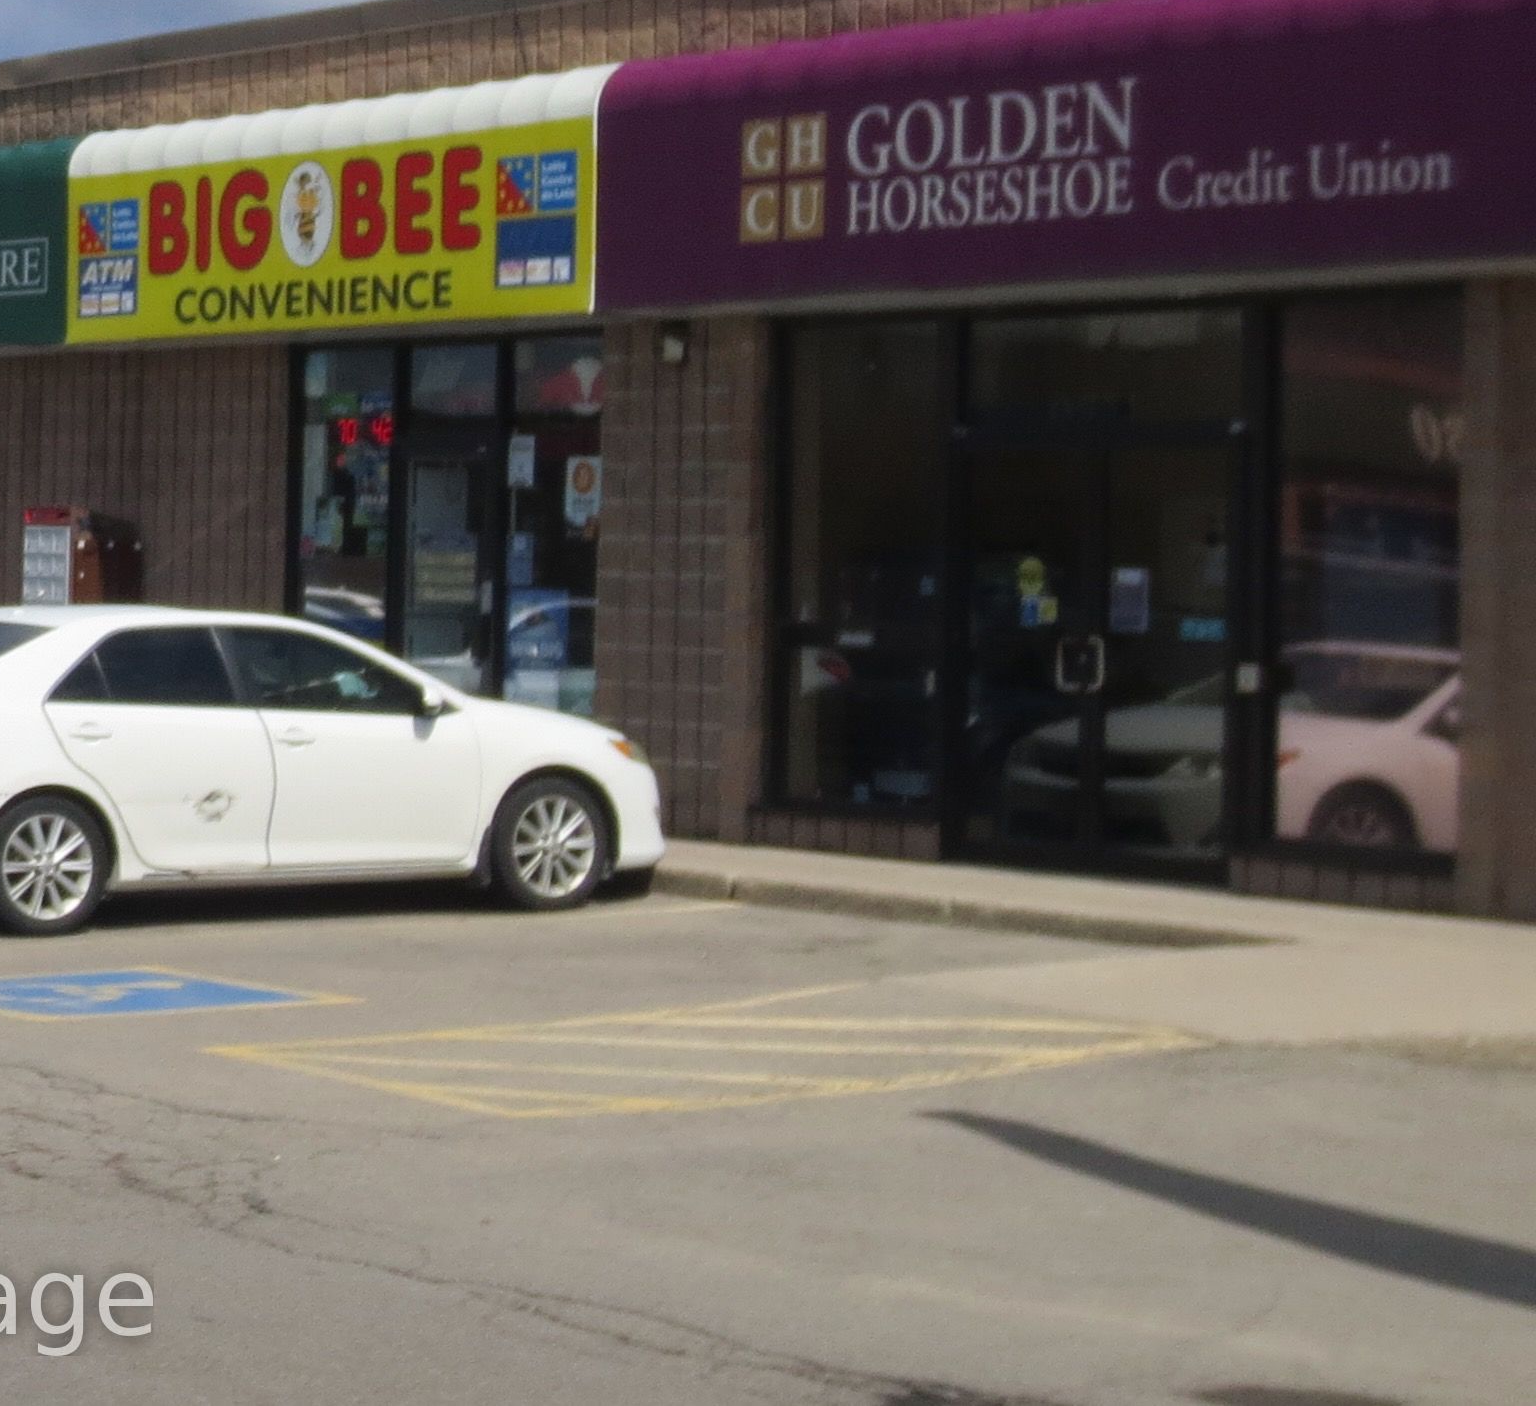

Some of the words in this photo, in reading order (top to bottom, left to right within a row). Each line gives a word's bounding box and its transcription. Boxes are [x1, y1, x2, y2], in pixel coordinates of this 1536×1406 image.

[846, 79, 1136, 177] GOLDEN
[148, 168, 272, 276] BIG
[340, 146, 483, 260] BEE
[847, 156, 1134, 236] HORSESHOE
[1157, 146, 1295, 210] Credit
[1308, 139, 1453, 200] Union
[81, 258, 135, 285] ATM
[174, 270, 453, 325] CONVENIENCE
